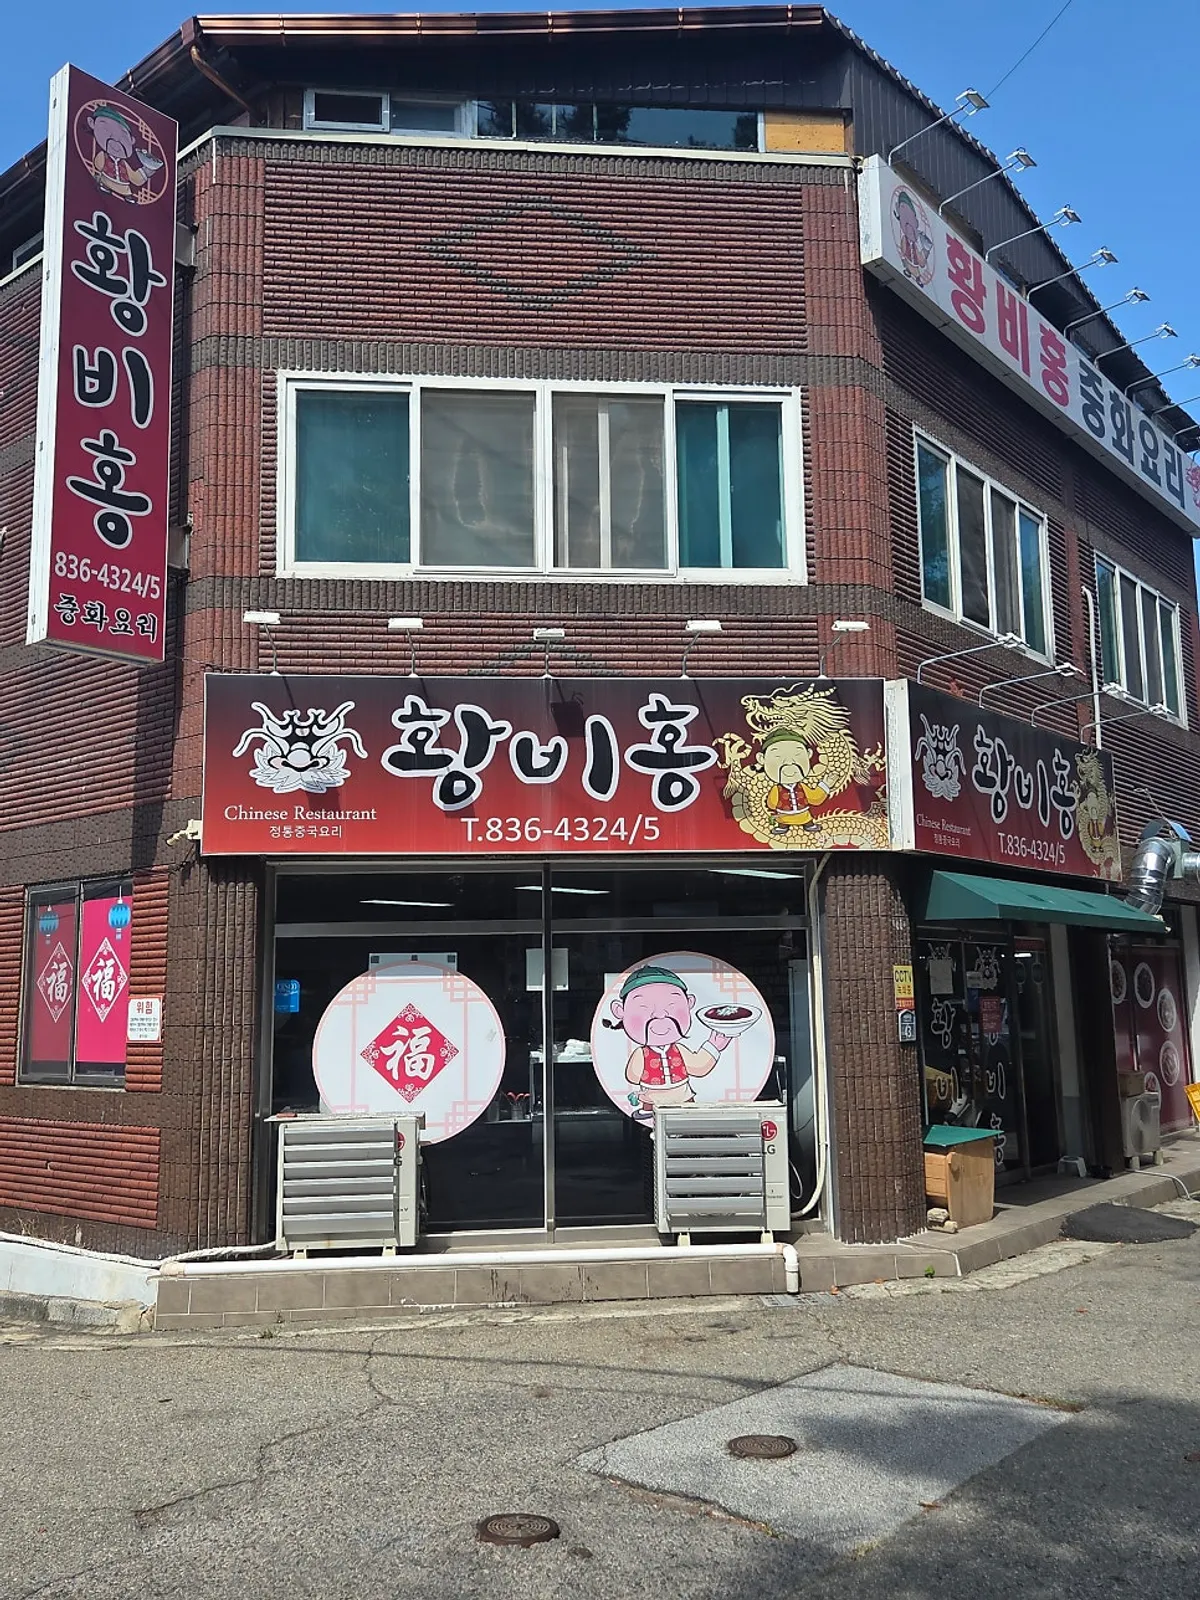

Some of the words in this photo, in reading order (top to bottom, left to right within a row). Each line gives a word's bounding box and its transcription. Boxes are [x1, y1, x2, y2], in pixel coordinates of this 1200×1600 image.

[66, 210, 167, 550] 황비홍
[946, 232, 1070, 408] 황비홍
[1077, 357, 1185, 510] 중화요리
[54, 551, 160, 599] 836-4324/5
[54, 593, 158, 644] 중화요리
[381, 694, 719, 813] 황비홍
[972, 724, 1079, 840] 황비홍
[224, 805, 289, 821] Chinese
[293, 805, 377, 821] Restaurant
[269, 825, 342, 839] 정통중국요리
[460, 813, 660, 845] T.836-4324/5
[915, 813, 941, 830] Chinese
[941, 818, 972, 836] Restaurant
[998, 832, 1066, 867] T.836-4324/5
[46, 961, 68, 1003] 福
[91, 957, 116, 1003] 福
[895, 970, 912, 983] CCTV
[136, 1001, 153, 1015] 위험
[380, 1026, 435, 1081] 福
